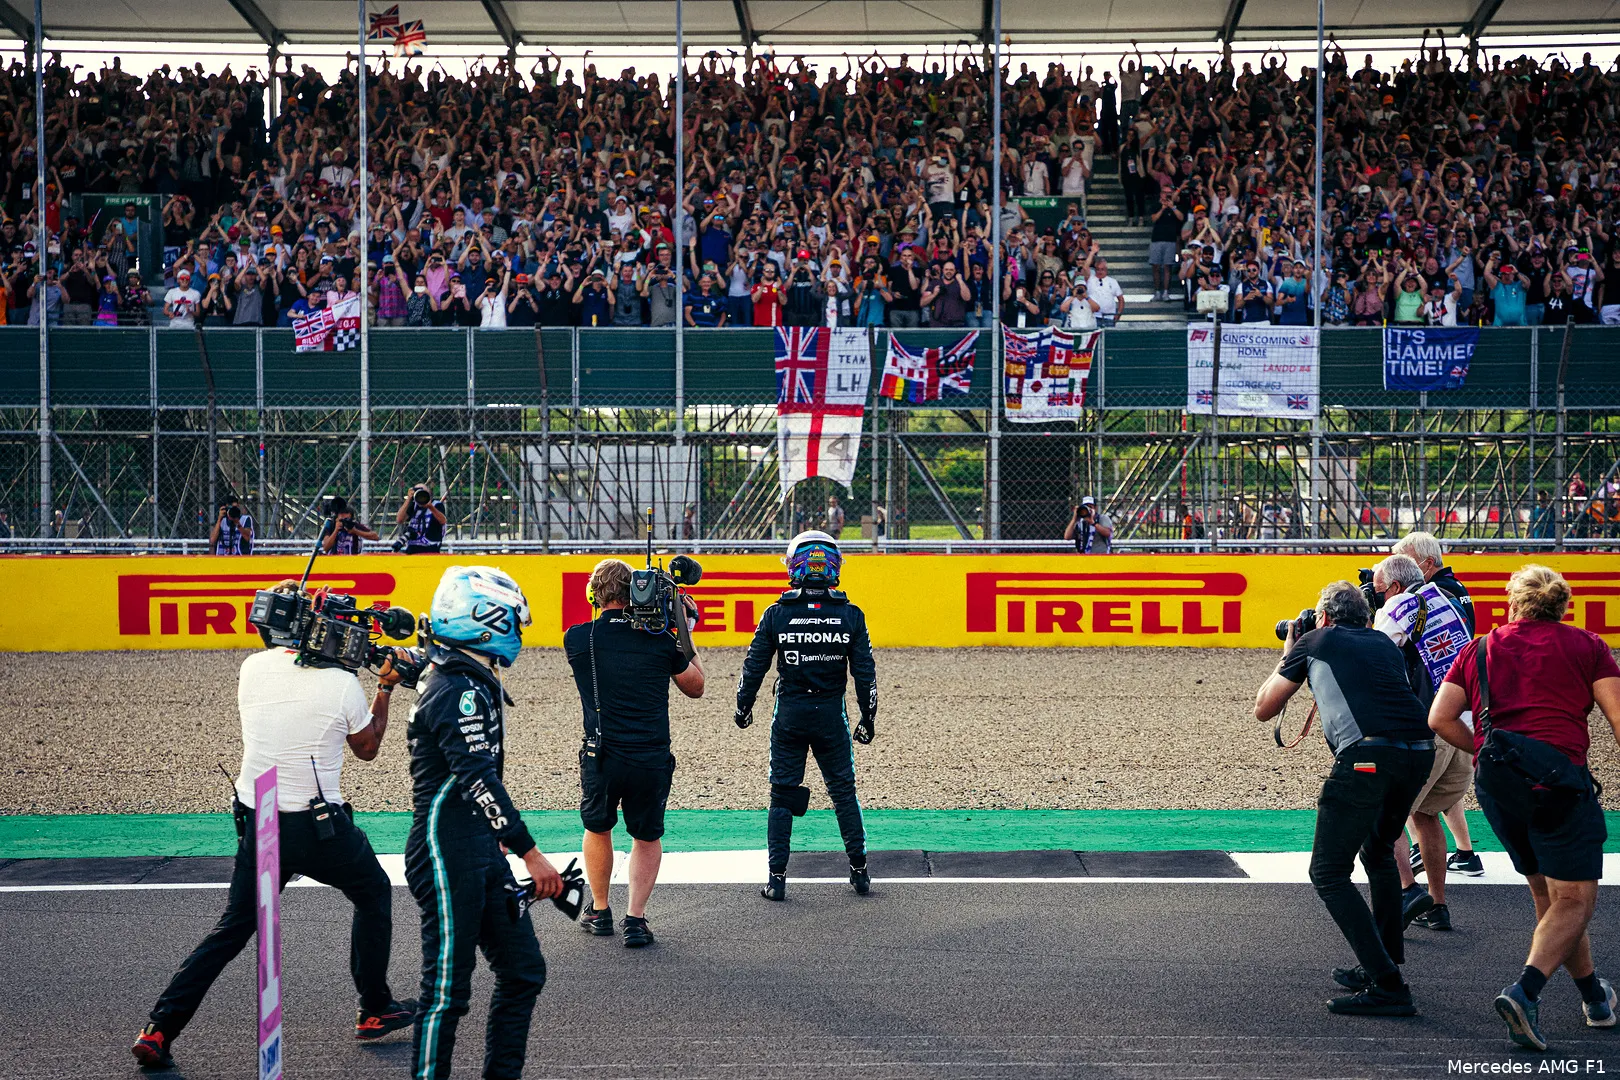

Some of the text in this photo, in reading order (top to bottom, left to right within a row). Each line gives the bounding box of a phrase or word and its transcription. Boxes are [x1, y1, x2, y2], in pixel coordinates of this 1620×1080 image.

[1255, 336, 1296, 346] COMING
[1386, 328, 1426, 345] IT'S
[1237, 347, 1267, 358] HOME
[838, 354, 867, 365] TEAM
[1195, 360, 1223, 370] LEWS
[1263, 364, 1311, 373] LANDO #4
[1386, 360, 1443, 377] TIME!
[837, 373, 862, 392] LH
[1225, 380, 1282, 391] GEORGE #63
[118, 573, 396, 635] PIRI
[966, 572, 1248, 635] PIRELLI
[804, 617, 841, 625] AMG
[778, 632, 851, 644] PETRONAS
[801, 653, 844, 662] TeamViewer
[469, 778, 508, 830] INEOS
